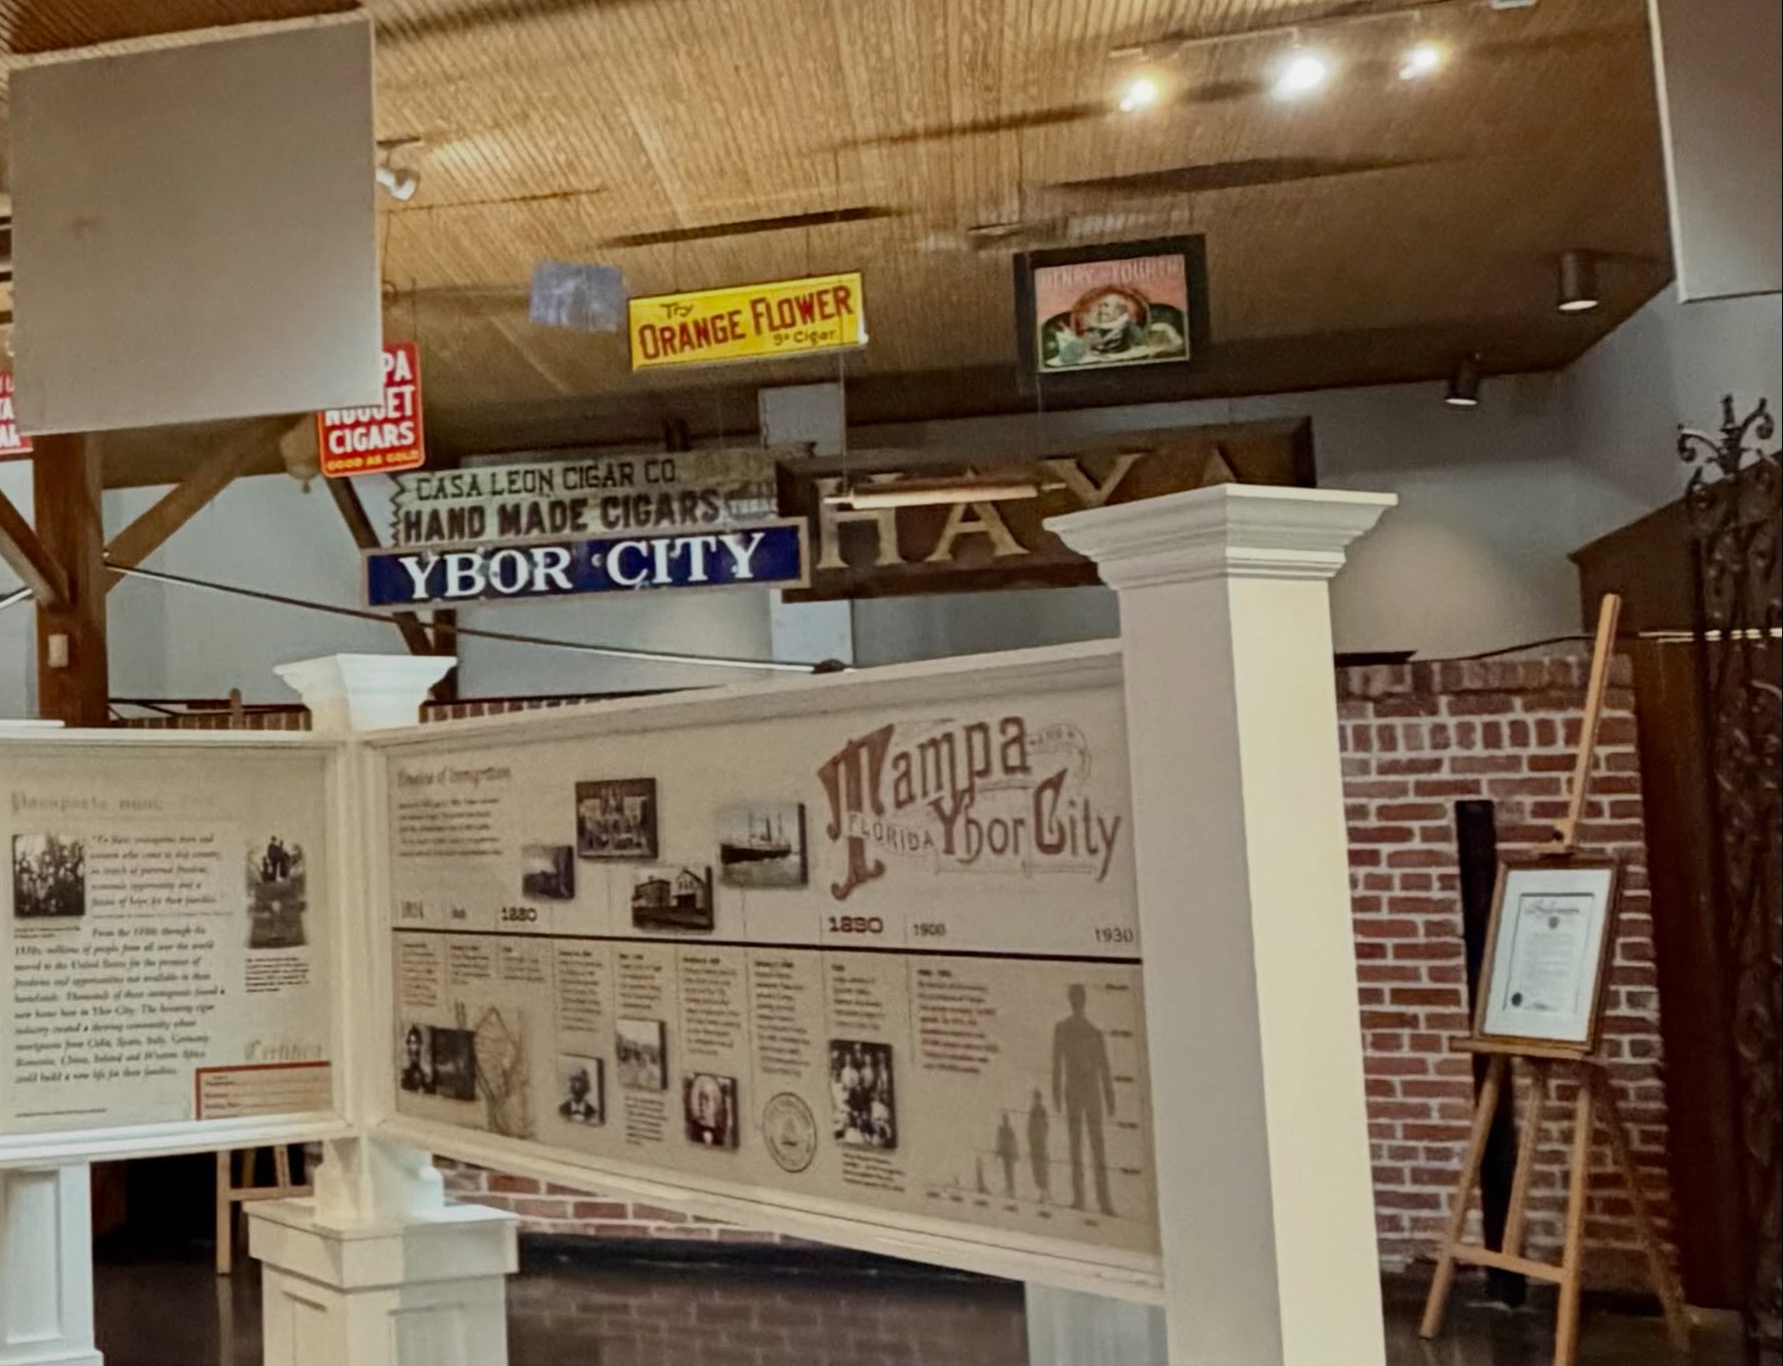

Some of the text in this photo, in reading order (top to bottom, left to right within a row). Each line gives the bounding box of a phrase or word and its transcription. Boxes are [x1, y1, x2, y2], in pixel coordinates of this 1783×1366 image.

[637, 283, 854, 361] ORANGE FLOWER
[660, 301, 695, 320] Try
[328, 420, 416, 455] CIGARS
[417, 474, 484, 502] CASA
[490, 468, 555, 496] LEON
[562, 461, 636, 491] CIGAR
[401, 489, 721, 544] HAND MADE CIGARS
[398, 531, 767, 601] YBOR CITY
[818, 715, 1033, 902] Tampa
[848, 813, 936, 852] FLORIDA
[927, 767, 1123, 883] Ybor City
[1094, 926, 1134, 943] 1930
